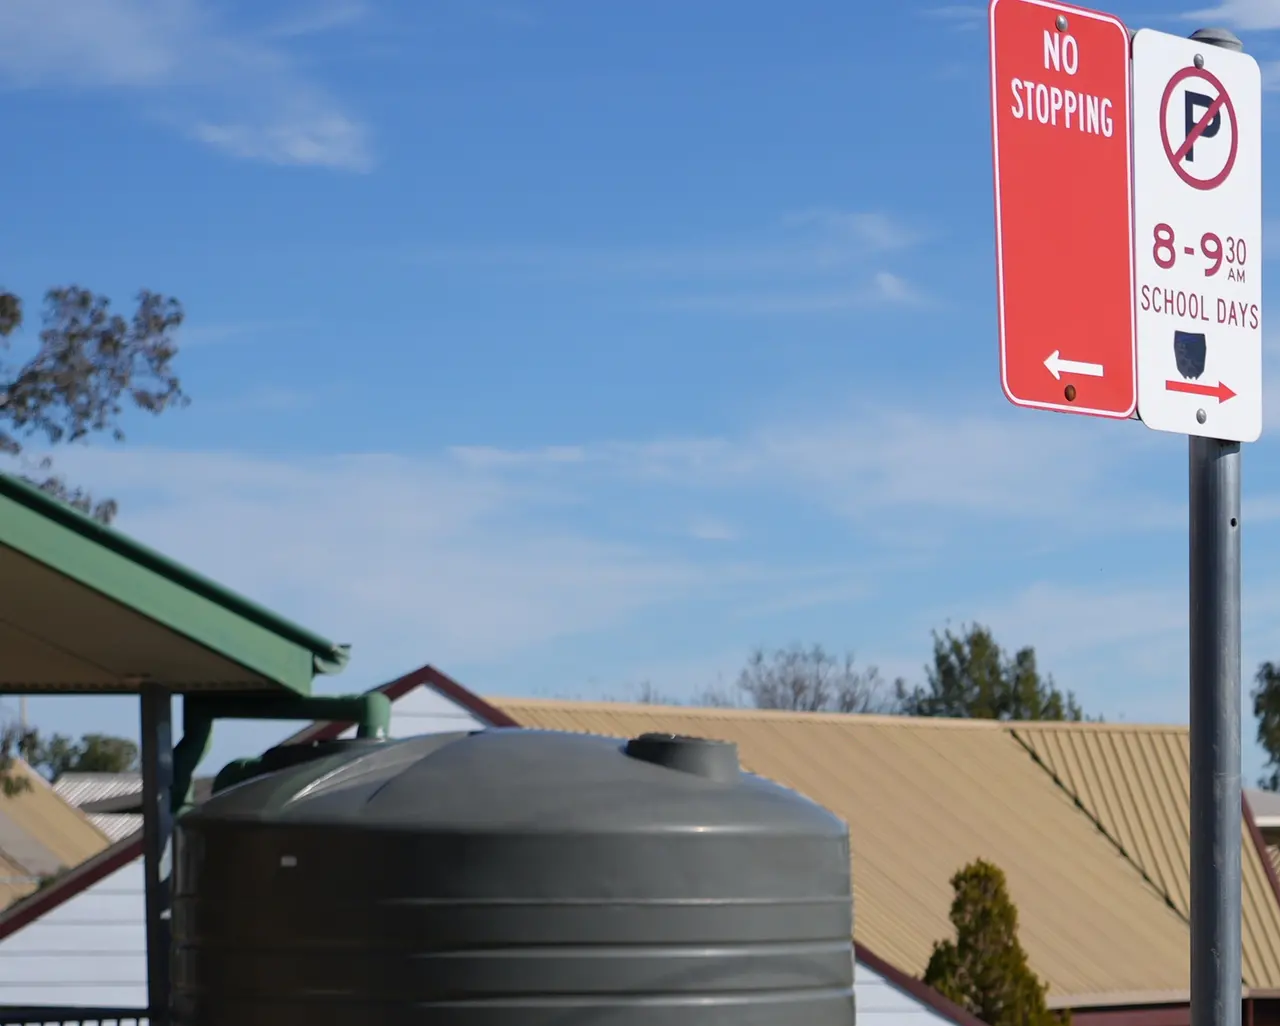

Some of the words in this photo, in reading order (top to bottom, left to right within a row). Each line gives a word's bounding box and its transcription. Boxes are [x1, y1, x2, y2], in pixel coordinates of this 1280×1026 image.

[1044, 30, 1078, 75] NO
[1011, 78, 1113, 137] STOPPING
[1228, 268, 1245, 283] AM
[1141, 285, 1209, 321] SCHOOL
[1217, 298, 1258, 329] DAYS
